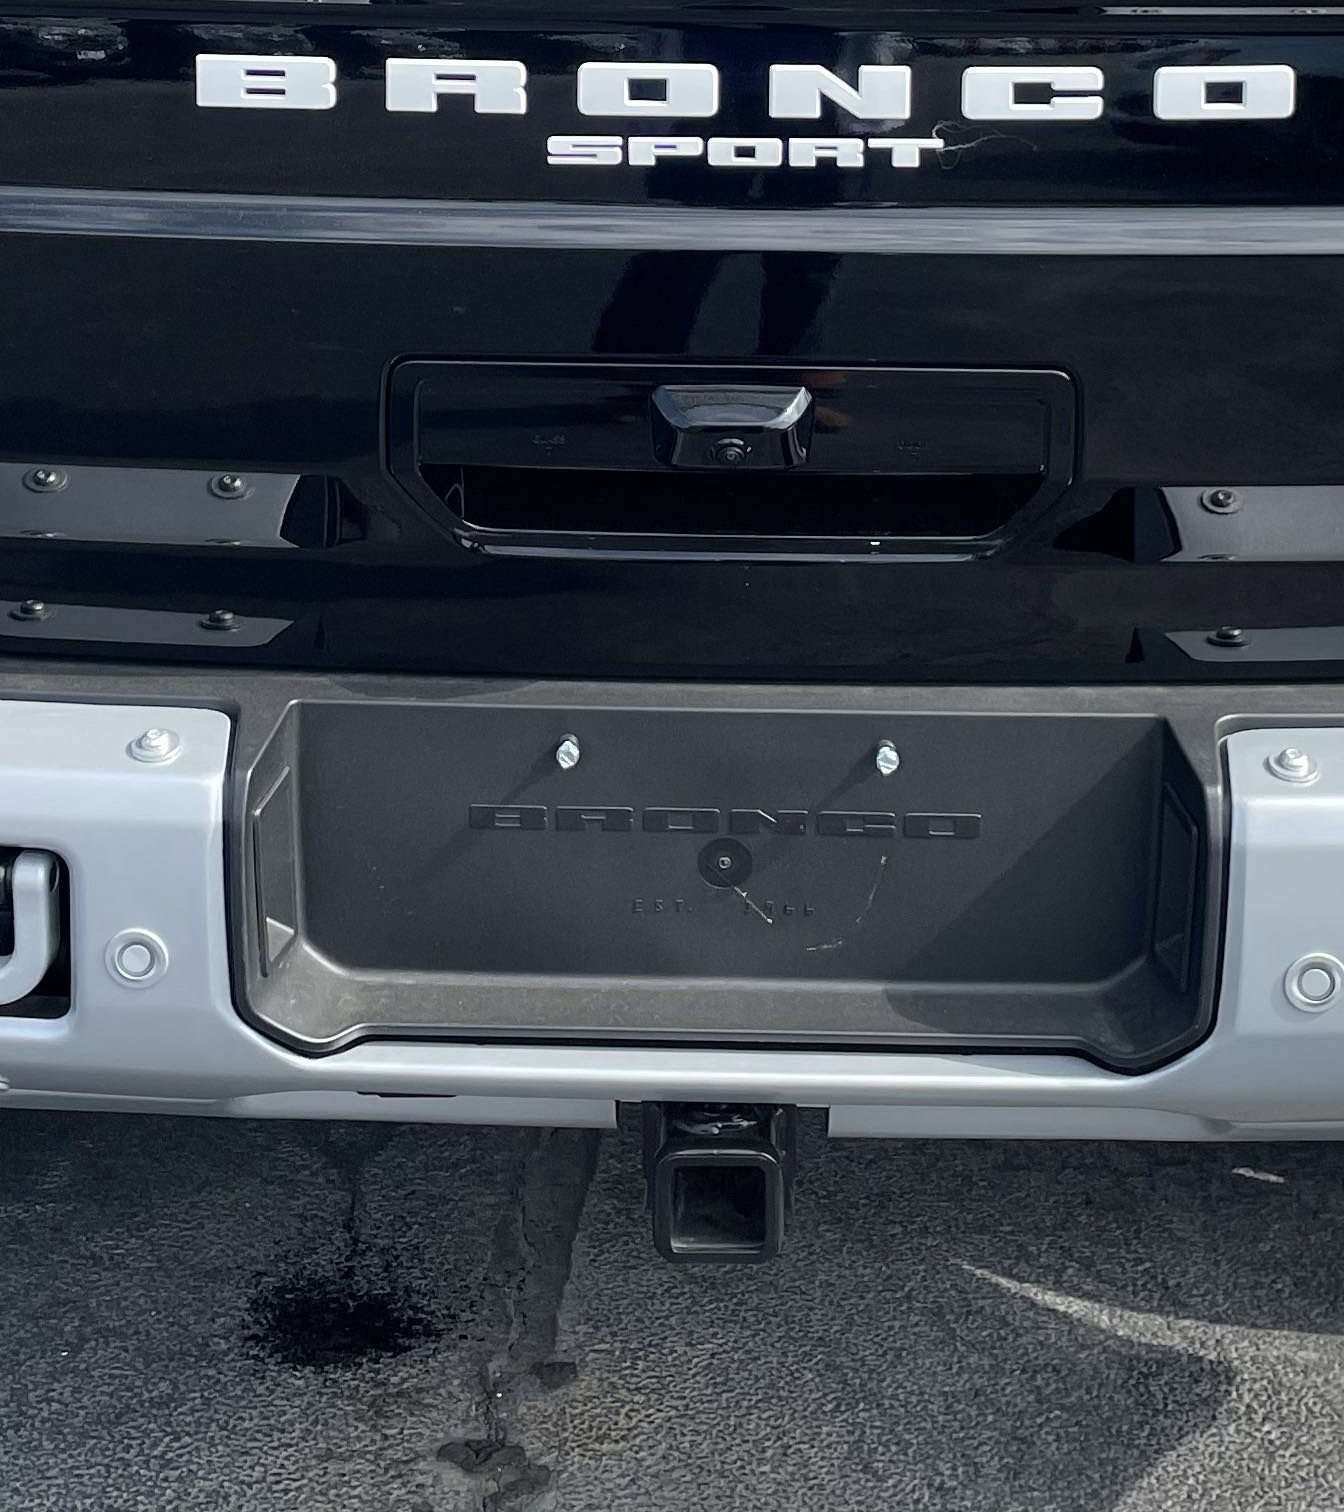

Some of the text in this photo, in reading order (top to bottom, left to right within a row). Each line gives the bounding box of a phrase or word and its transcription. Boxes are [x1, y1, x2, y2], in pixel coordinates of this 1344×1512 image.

[194, 52, 1297, 121] BRONCO
[545, 135, 945, 169] SPORT
[468, 803, 983, 840] BRONCO
